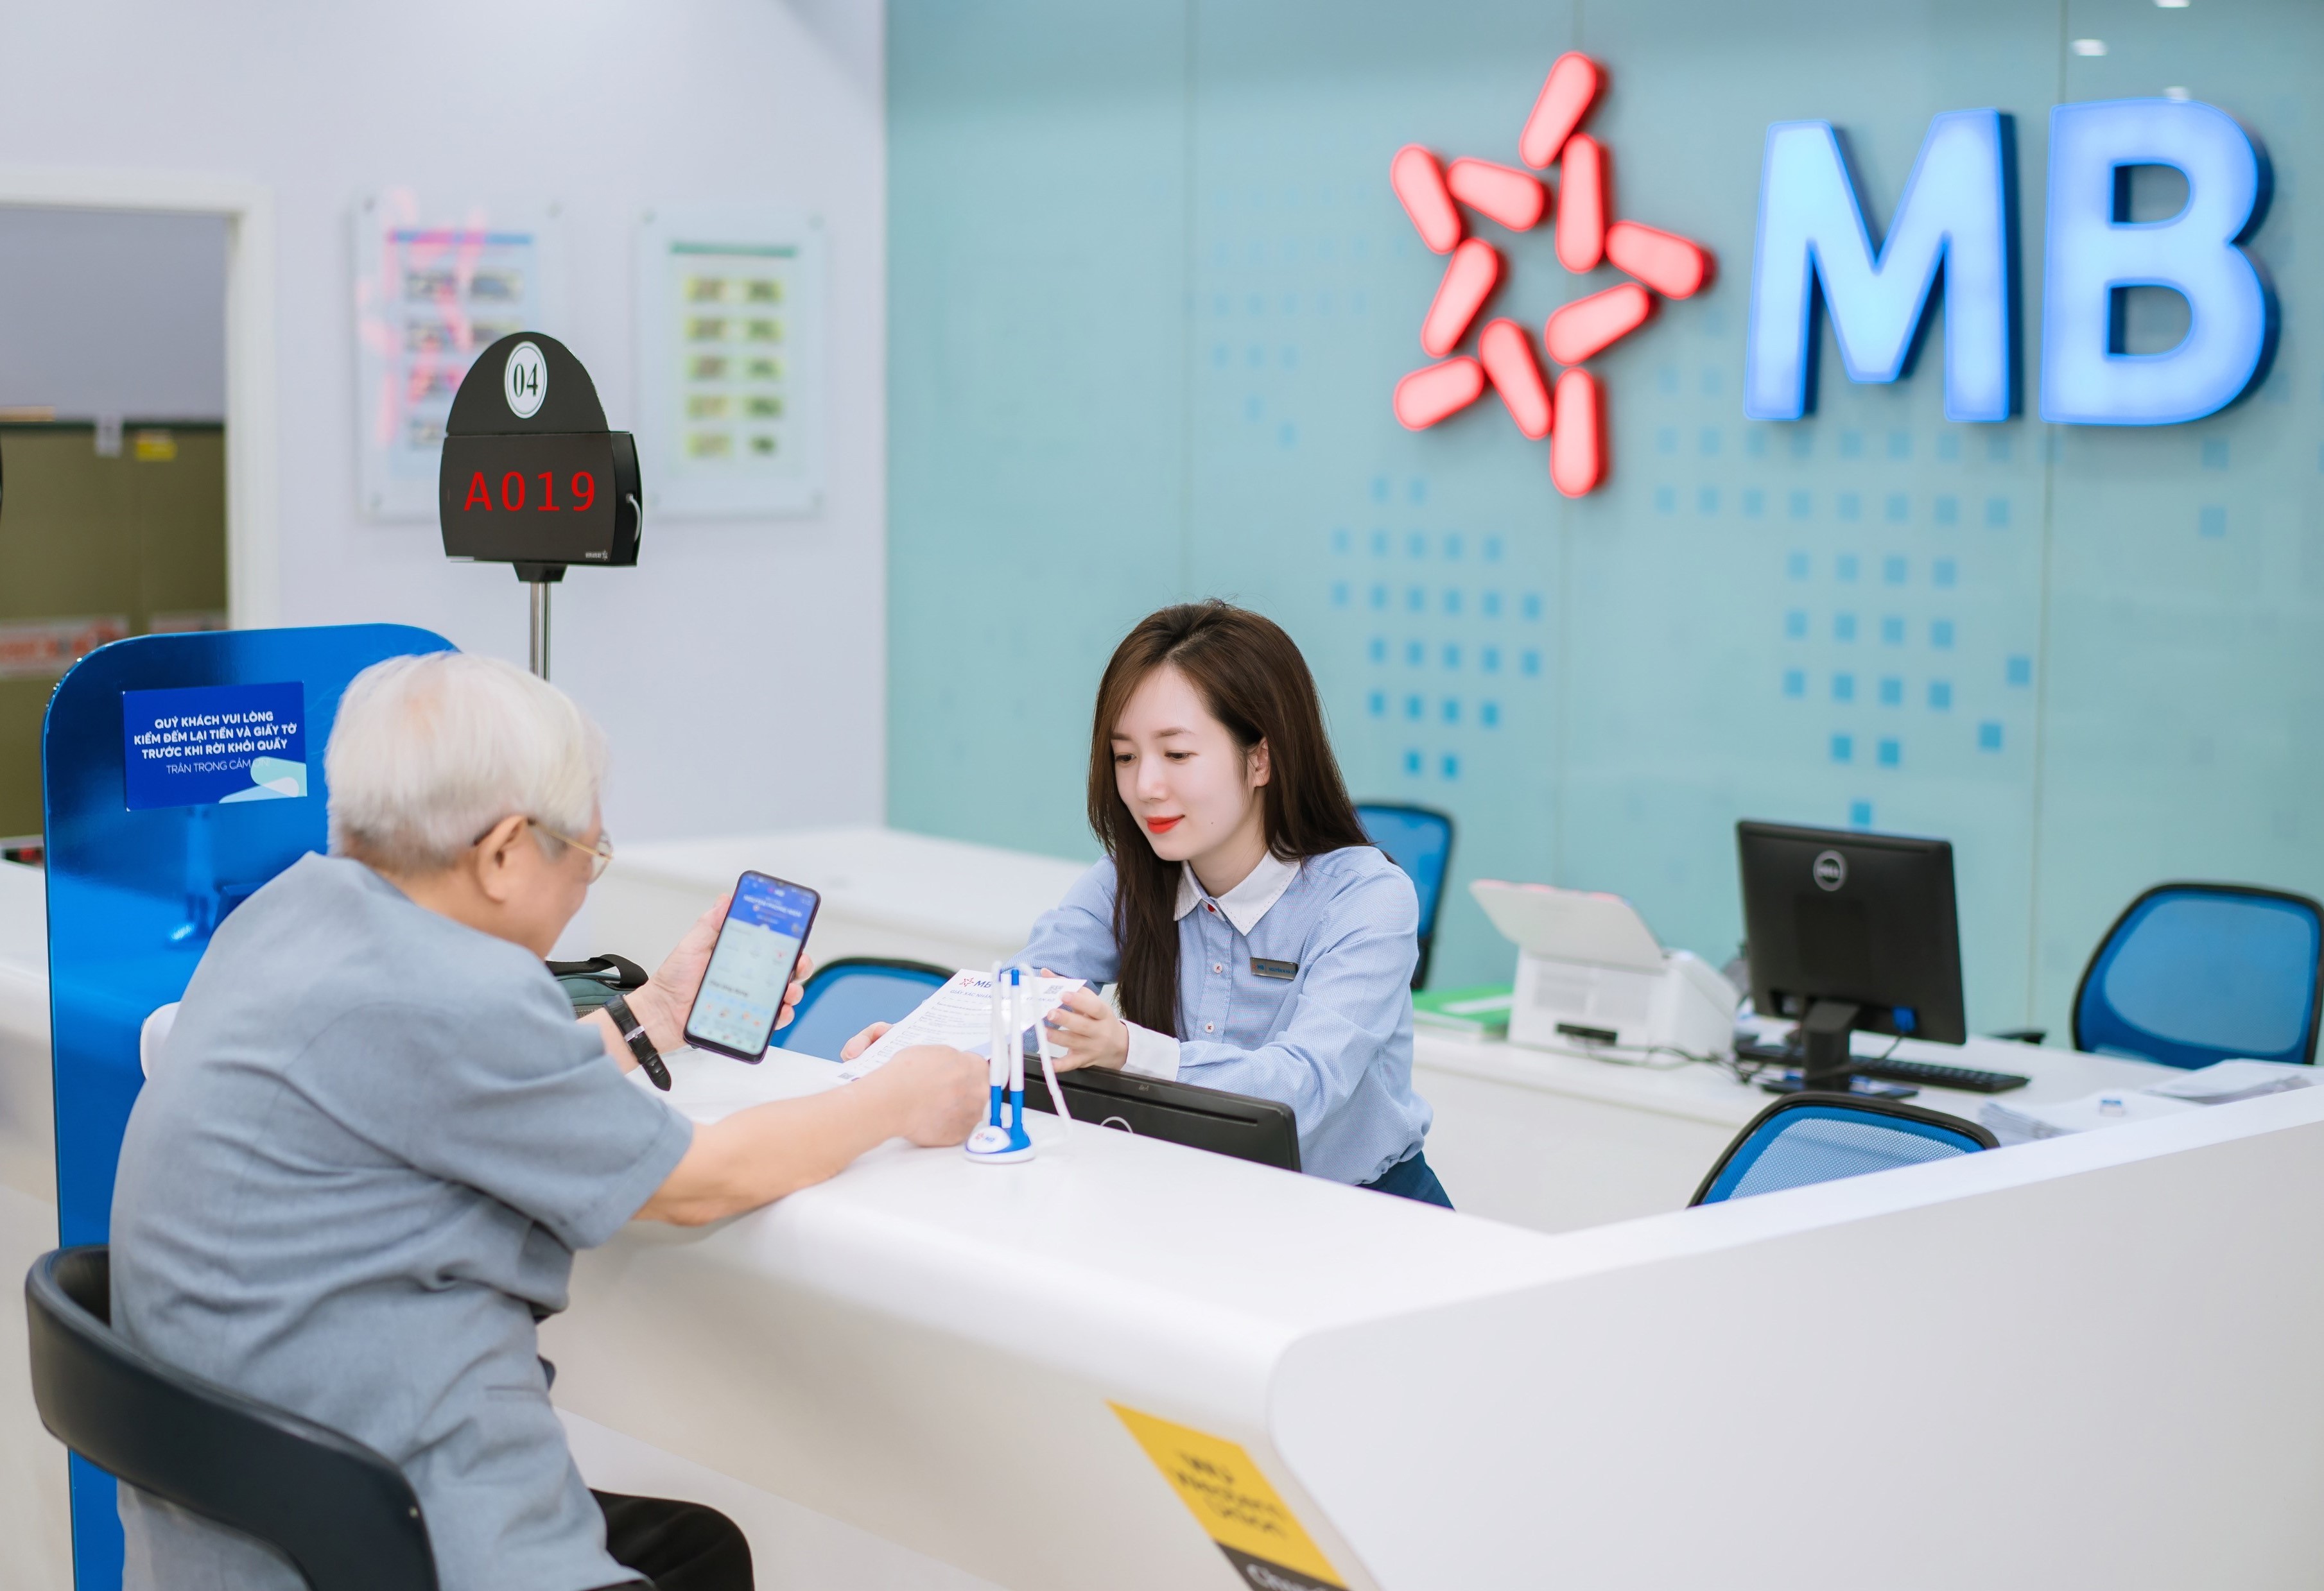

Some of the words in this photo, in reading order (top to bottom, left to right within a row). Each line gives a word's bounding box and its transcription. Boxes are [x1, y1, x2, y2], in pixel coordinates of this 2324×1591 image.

[1744, 97, 2279, 426] MB
[513, 363, 539, 398] 04
[464, 471, 595, 512] A019
[155, 716, 178, 729] QUÝ
[181, 714, 220, 727] KHÁCH
[221, 713, 240, 725] VUI
[243, 710, 273, 723] LÒNG
[134, 731, 161, 745] KIỂM
[163, 729, 187, 743] ĐẾM
[190, 730, 207, 743] LẠI
[209, 726, 234, 739] TIỀN
[236, 725, 251, 737] VÀ
[254, 723, 279, 736] GIẤY
[281, 722, 297, 734] TỜ
[142, 745, 182, 759] TRƯỚC
[184, 745, 203, 756] KHI
[205, 742, 225, 754] RỜI
[193, 761, 227, 773] TRỌNG
[974, 980, 993, 988] MB
